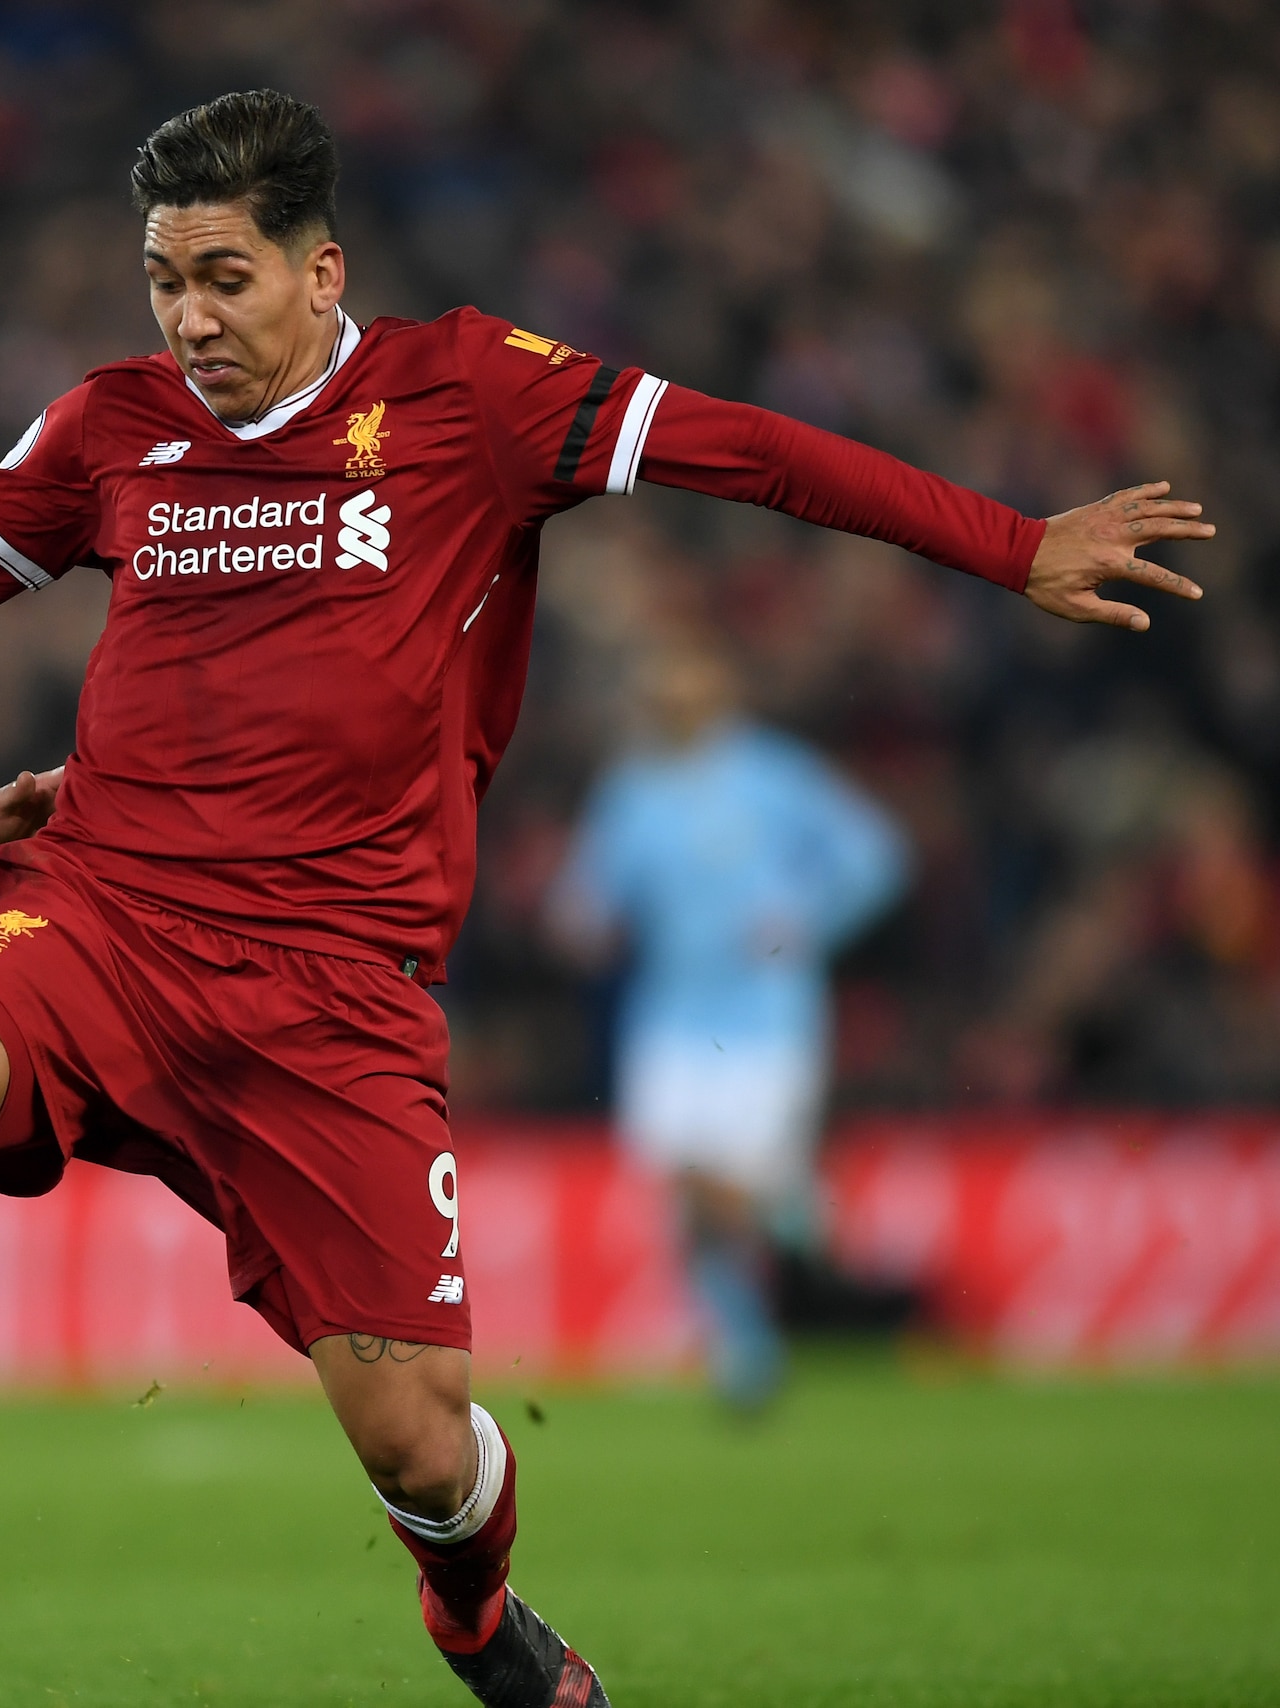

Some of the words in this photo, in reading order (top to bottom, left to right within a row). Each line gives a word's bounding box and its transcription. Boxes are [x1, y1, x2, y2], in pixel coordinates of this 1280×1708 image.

[359, 468, 385, 478] YEARS
[147, 492, 327, 537] Standard
[132, 534, 323, 581] Chartered
[428, 1152, 459, 1257] 9
